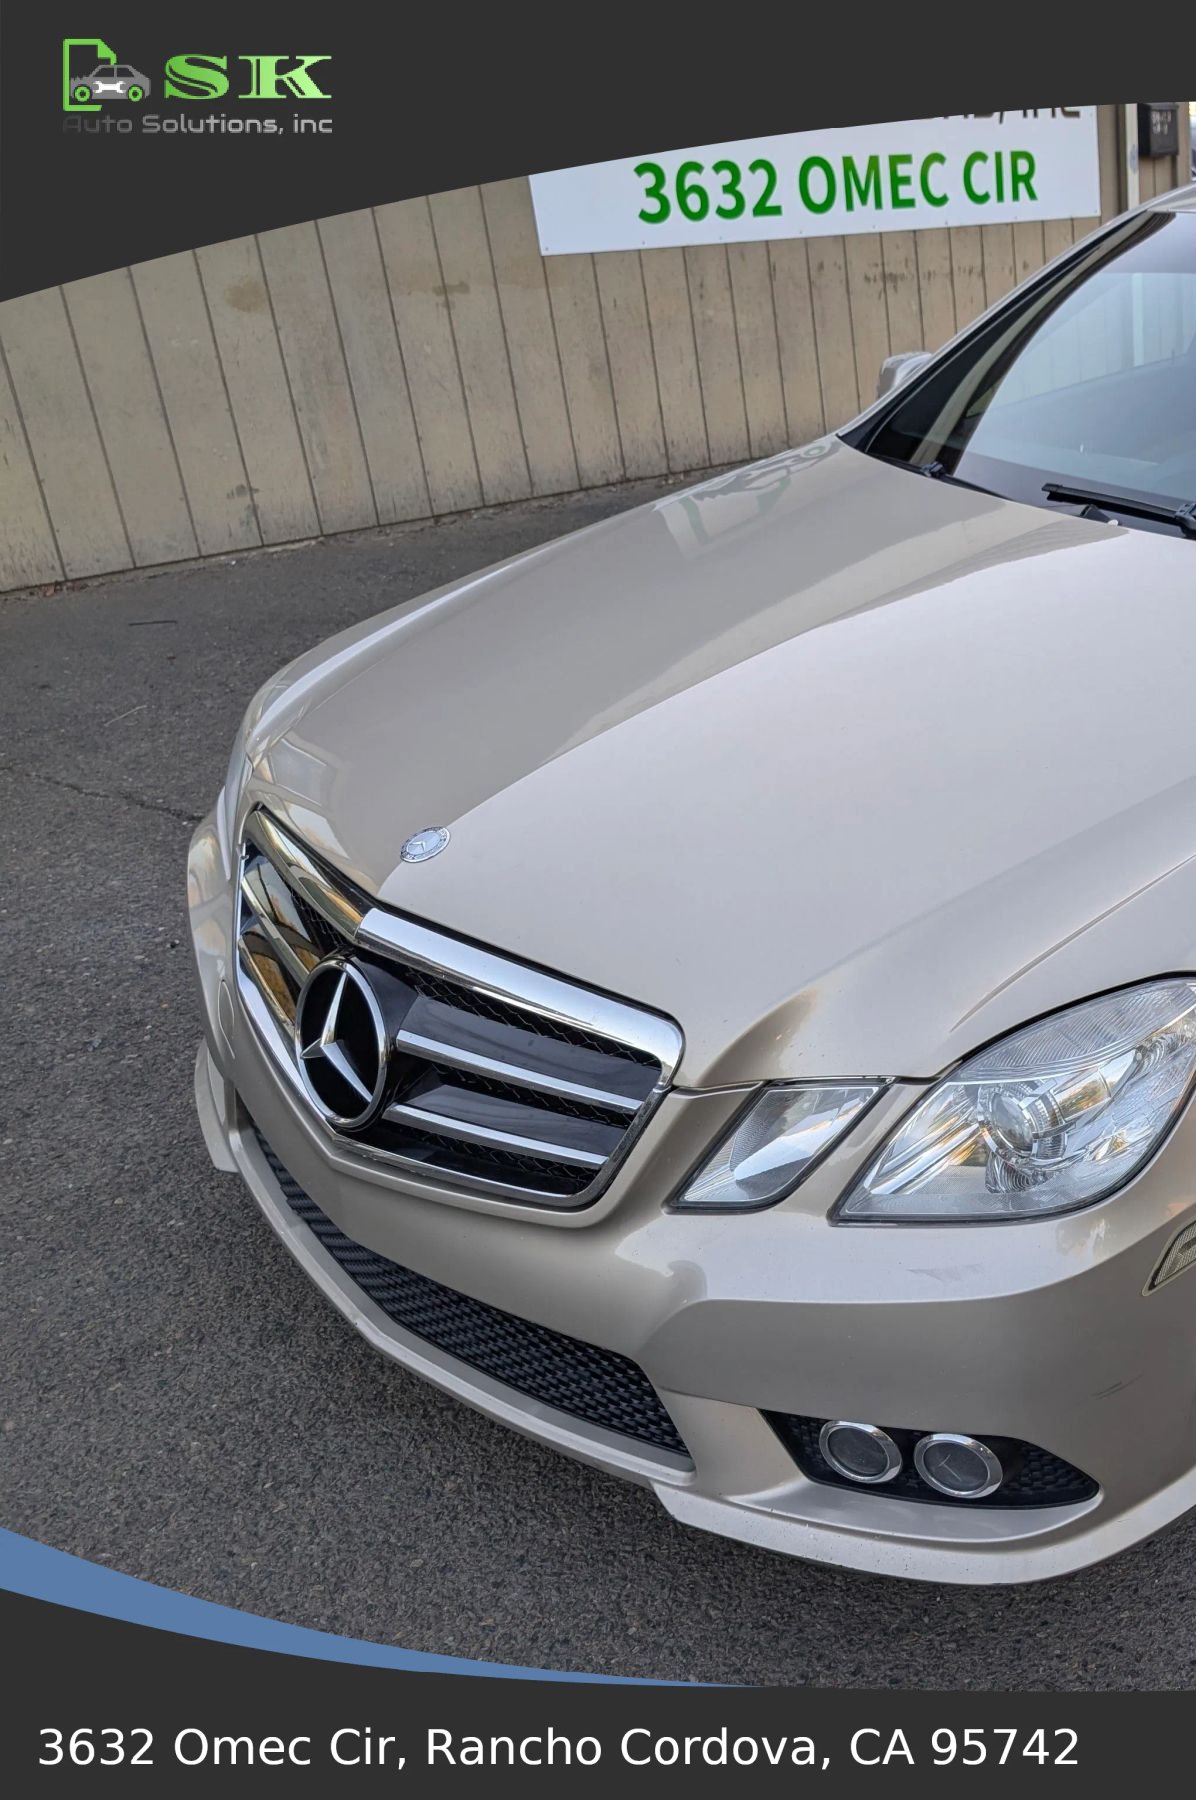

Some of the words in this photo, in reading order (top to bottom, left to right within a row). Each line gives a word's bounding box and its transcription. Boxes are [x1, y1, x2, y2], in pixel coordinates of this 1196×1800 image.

[634, 158, 782, 224] 3632
[798, 152, 949, 214] OMEC
[962, 149, 1038, 204] CIR
